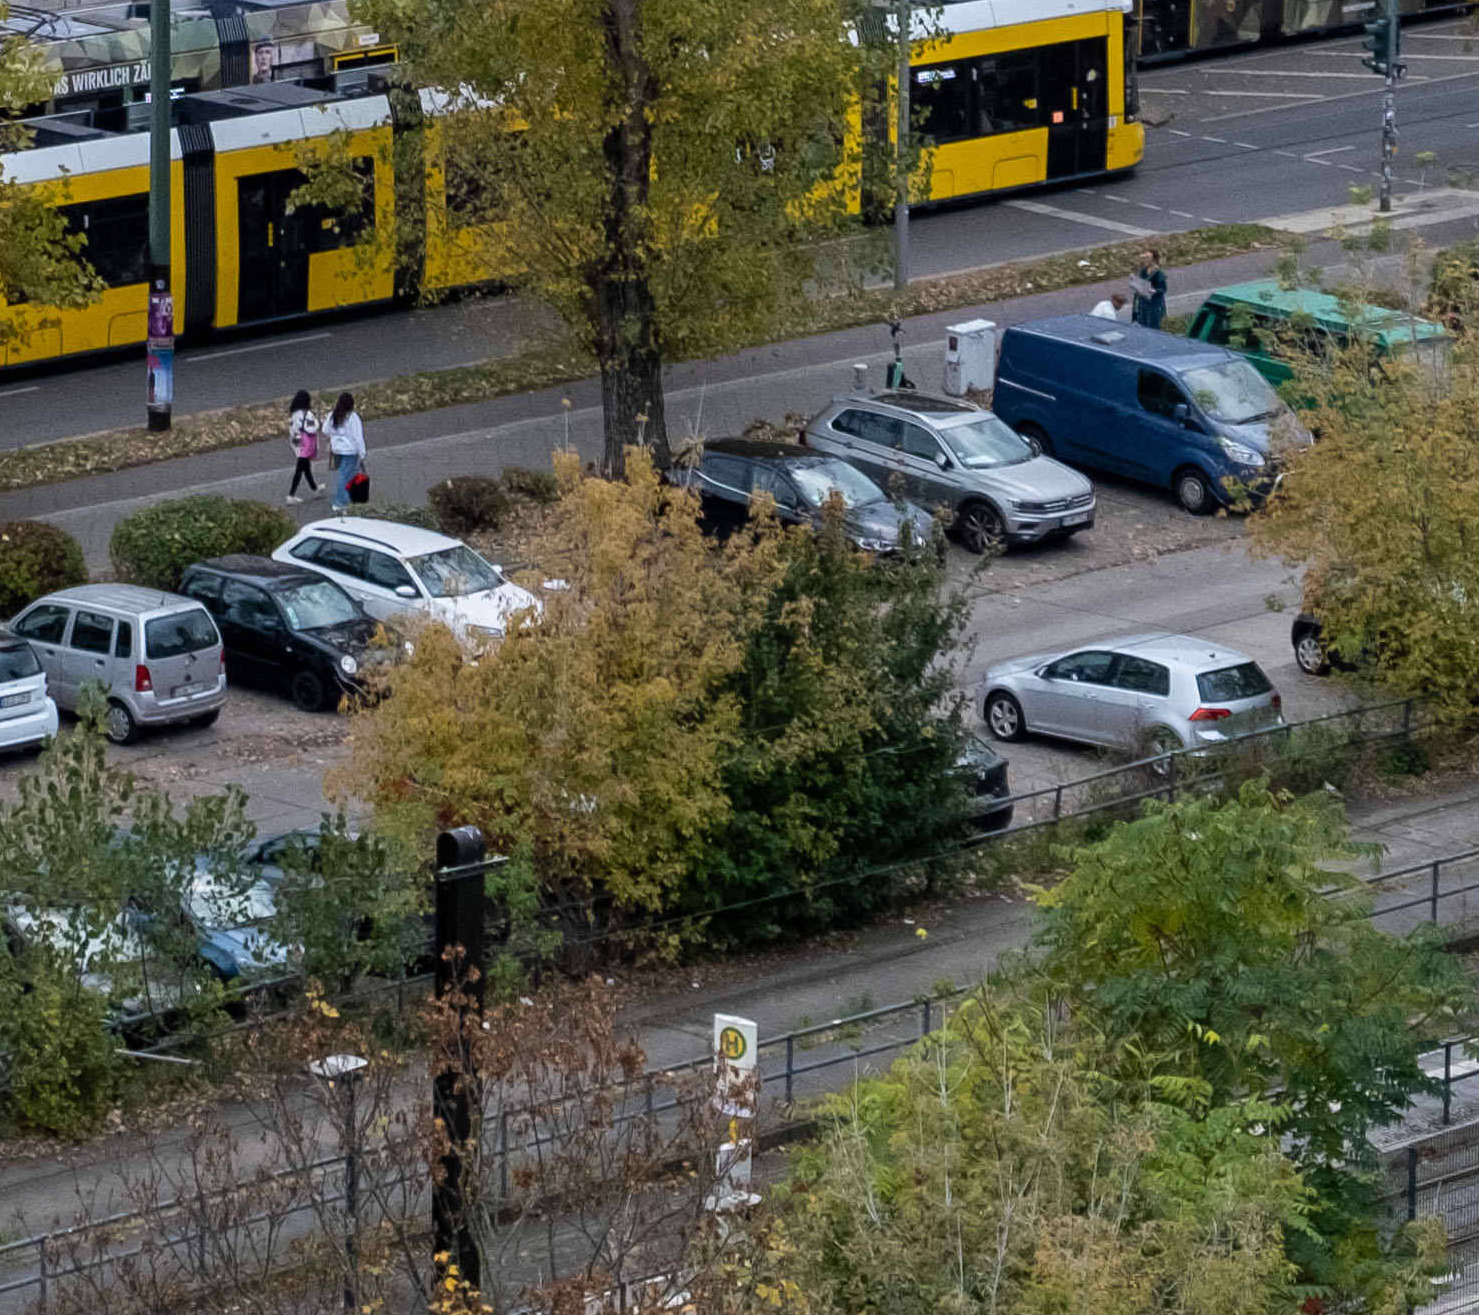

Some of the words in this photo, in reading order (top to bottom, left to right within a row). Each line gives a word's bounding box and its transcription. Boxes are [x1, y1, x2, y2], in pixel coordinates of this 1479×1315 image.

[52, 76, 69, 95] AS
[72, 66, 130, 92] WIRKLICH
[133, 59, 151, 83] ZÄ
